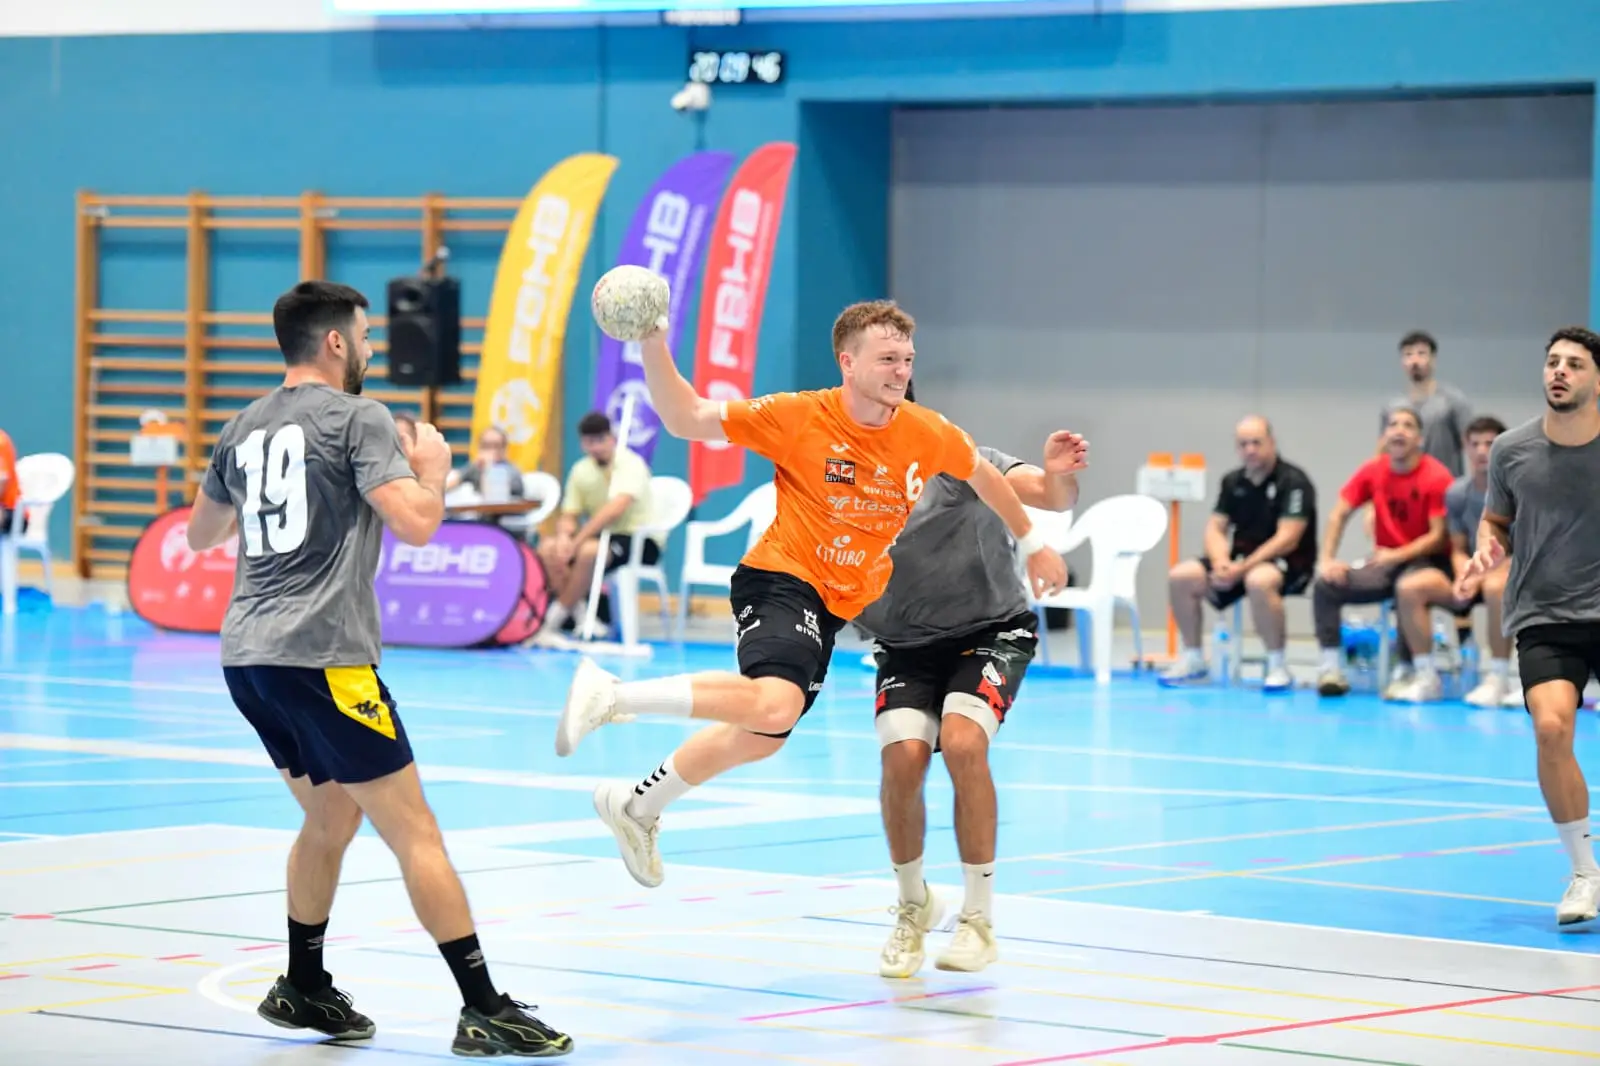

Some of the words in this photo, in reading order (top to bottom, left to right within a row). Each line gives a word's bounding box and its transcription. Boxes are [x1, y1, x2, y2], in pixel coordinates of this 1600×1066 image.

[709, 188, 762, 368] FBHB
[235, 424, 308, 556] 19
[906, 461, 923, 501] 6
[390, 543, 498, 574] FBHB
